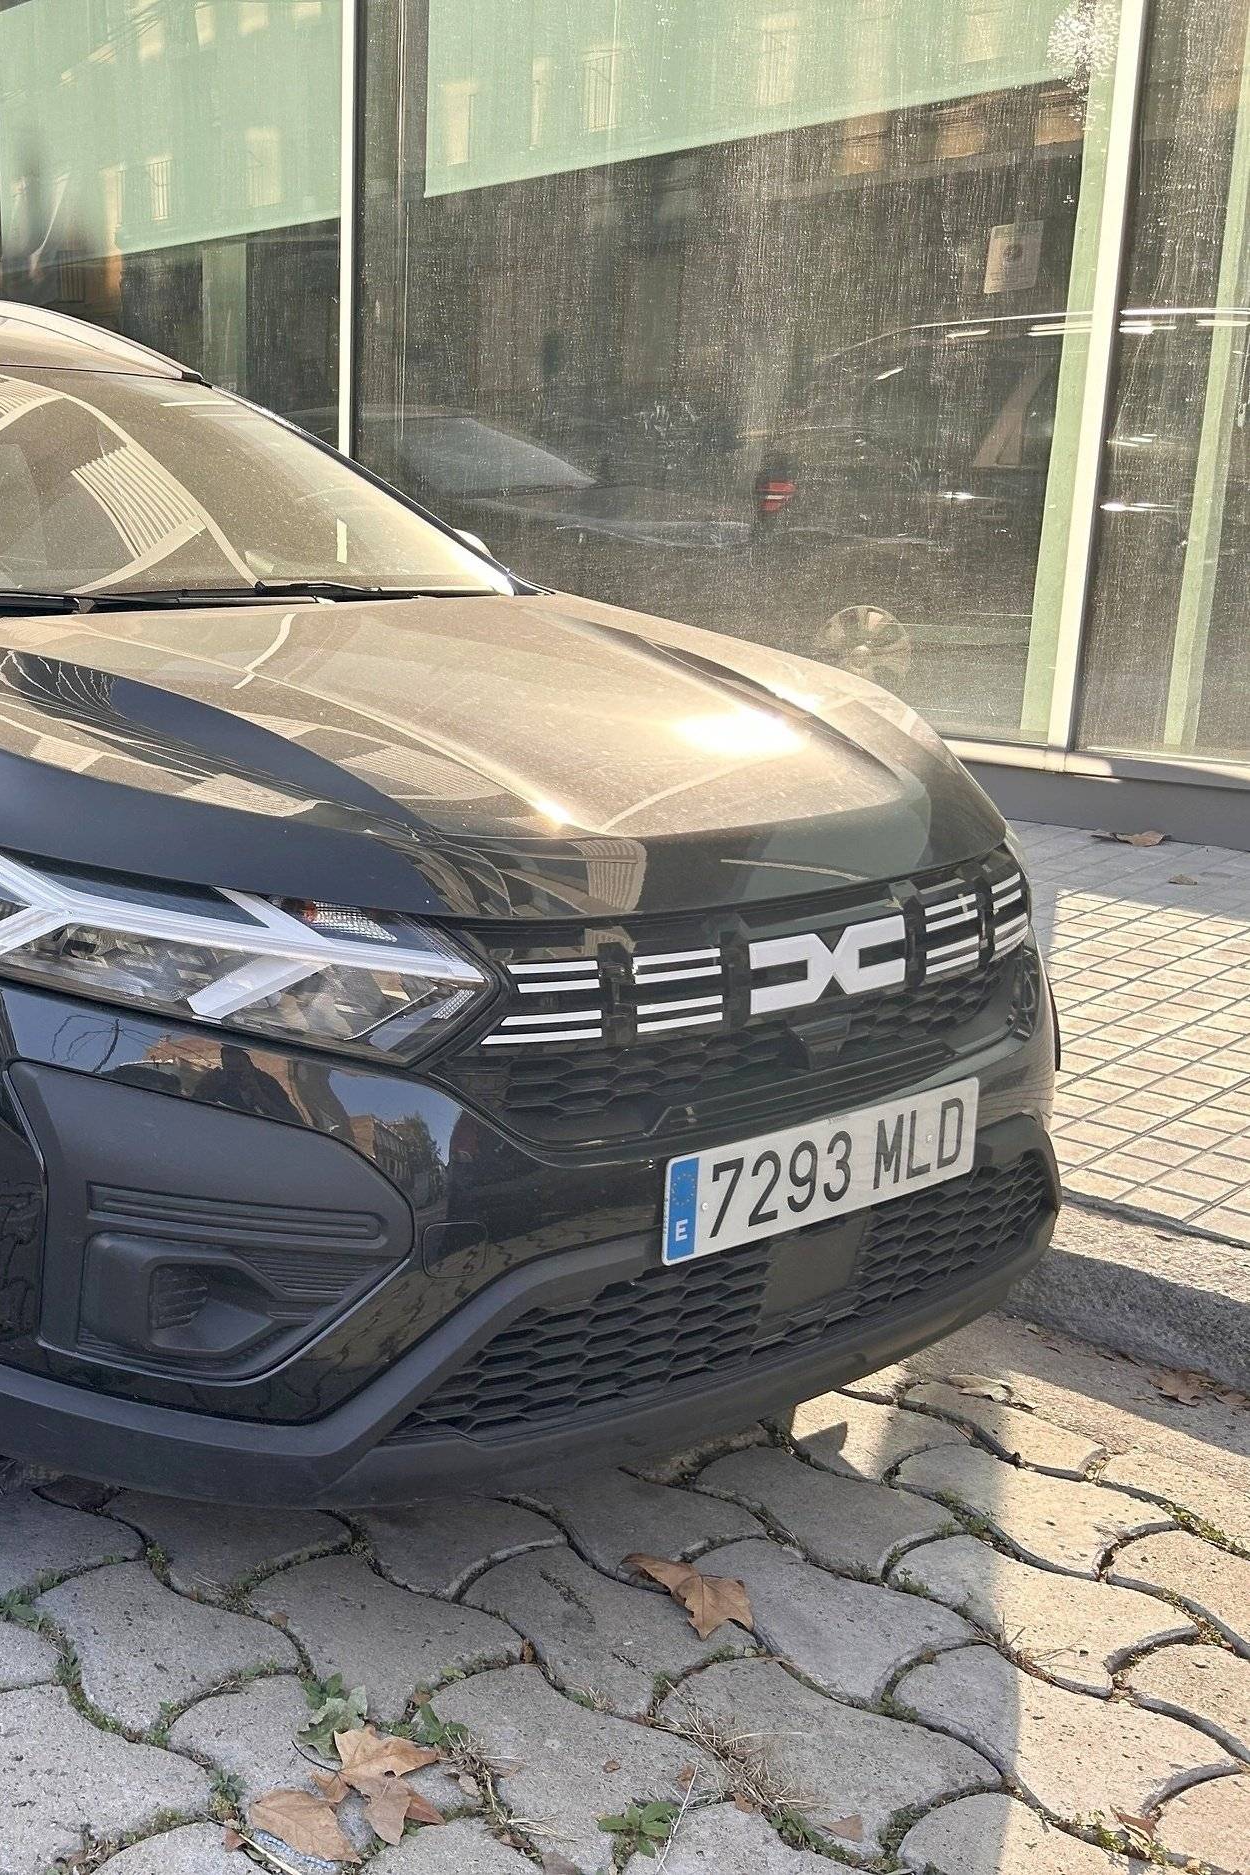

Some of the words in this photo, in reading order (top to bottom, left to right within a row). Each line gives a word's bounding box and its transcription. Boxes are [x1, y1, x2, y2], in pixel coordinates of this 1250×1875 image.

[709, 1130, 853, 1238] 7293
[873, 1097, 965, 1190] MLD
[675, 1218, 689, 1242] E
